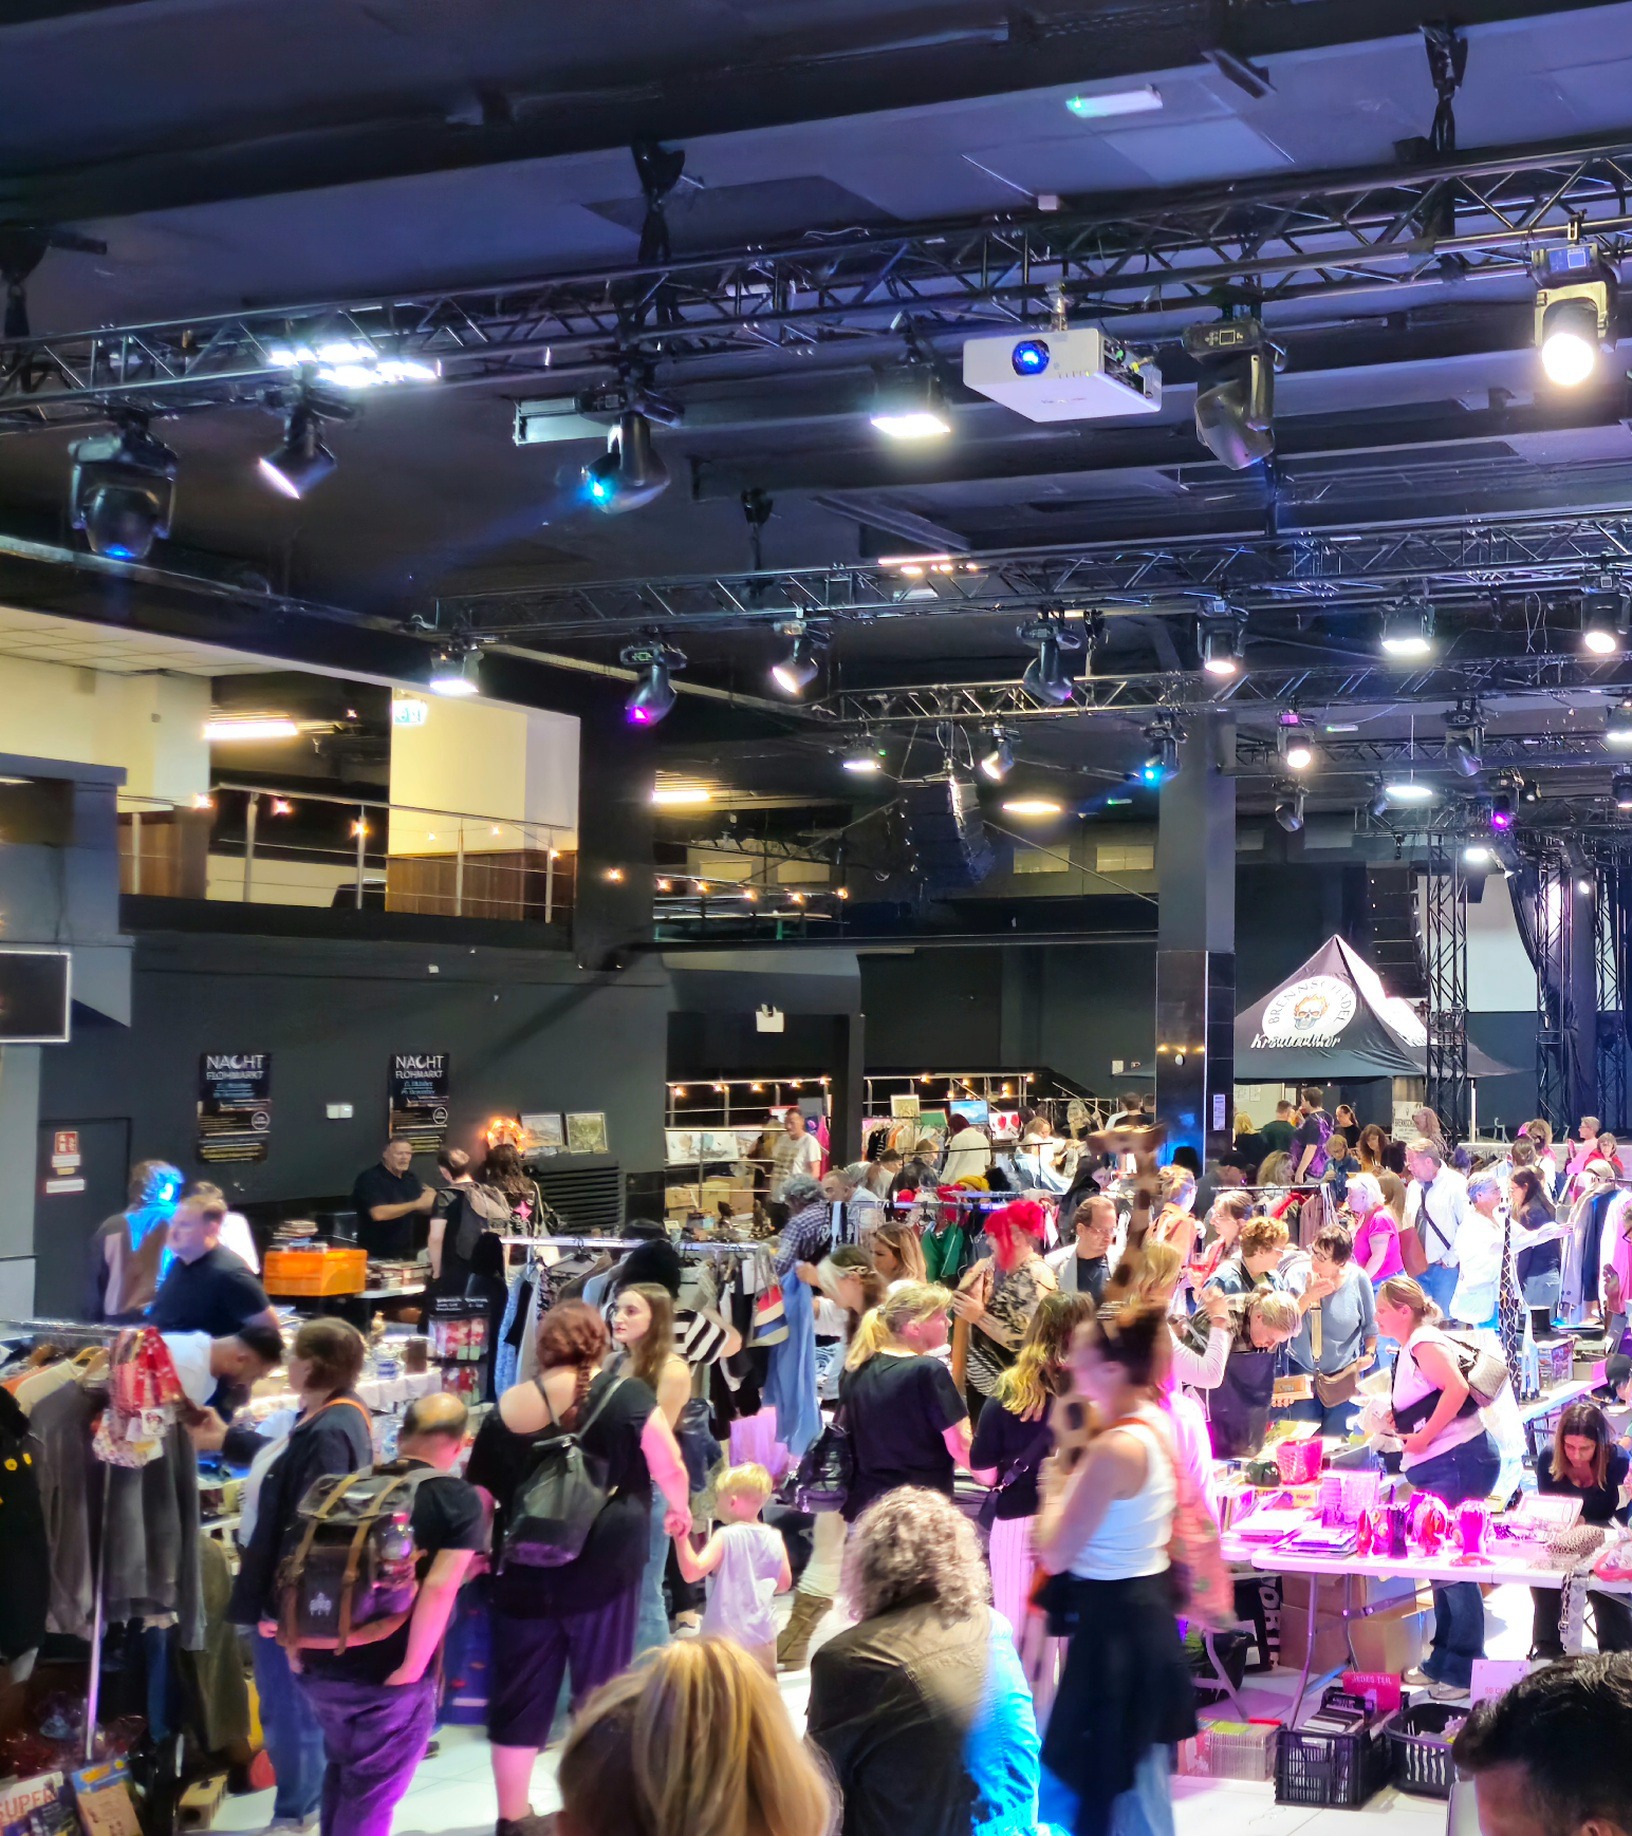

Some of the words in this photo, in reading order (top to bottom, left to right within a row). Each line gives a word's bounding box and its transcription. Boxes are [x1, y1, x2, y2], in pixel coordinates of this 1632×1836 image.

[206, 1054, 266, 1069] NACHT
[396, 1055, 444, 1069] NACHT
[396, 1070, 443, 1079] FLOHMARKT
